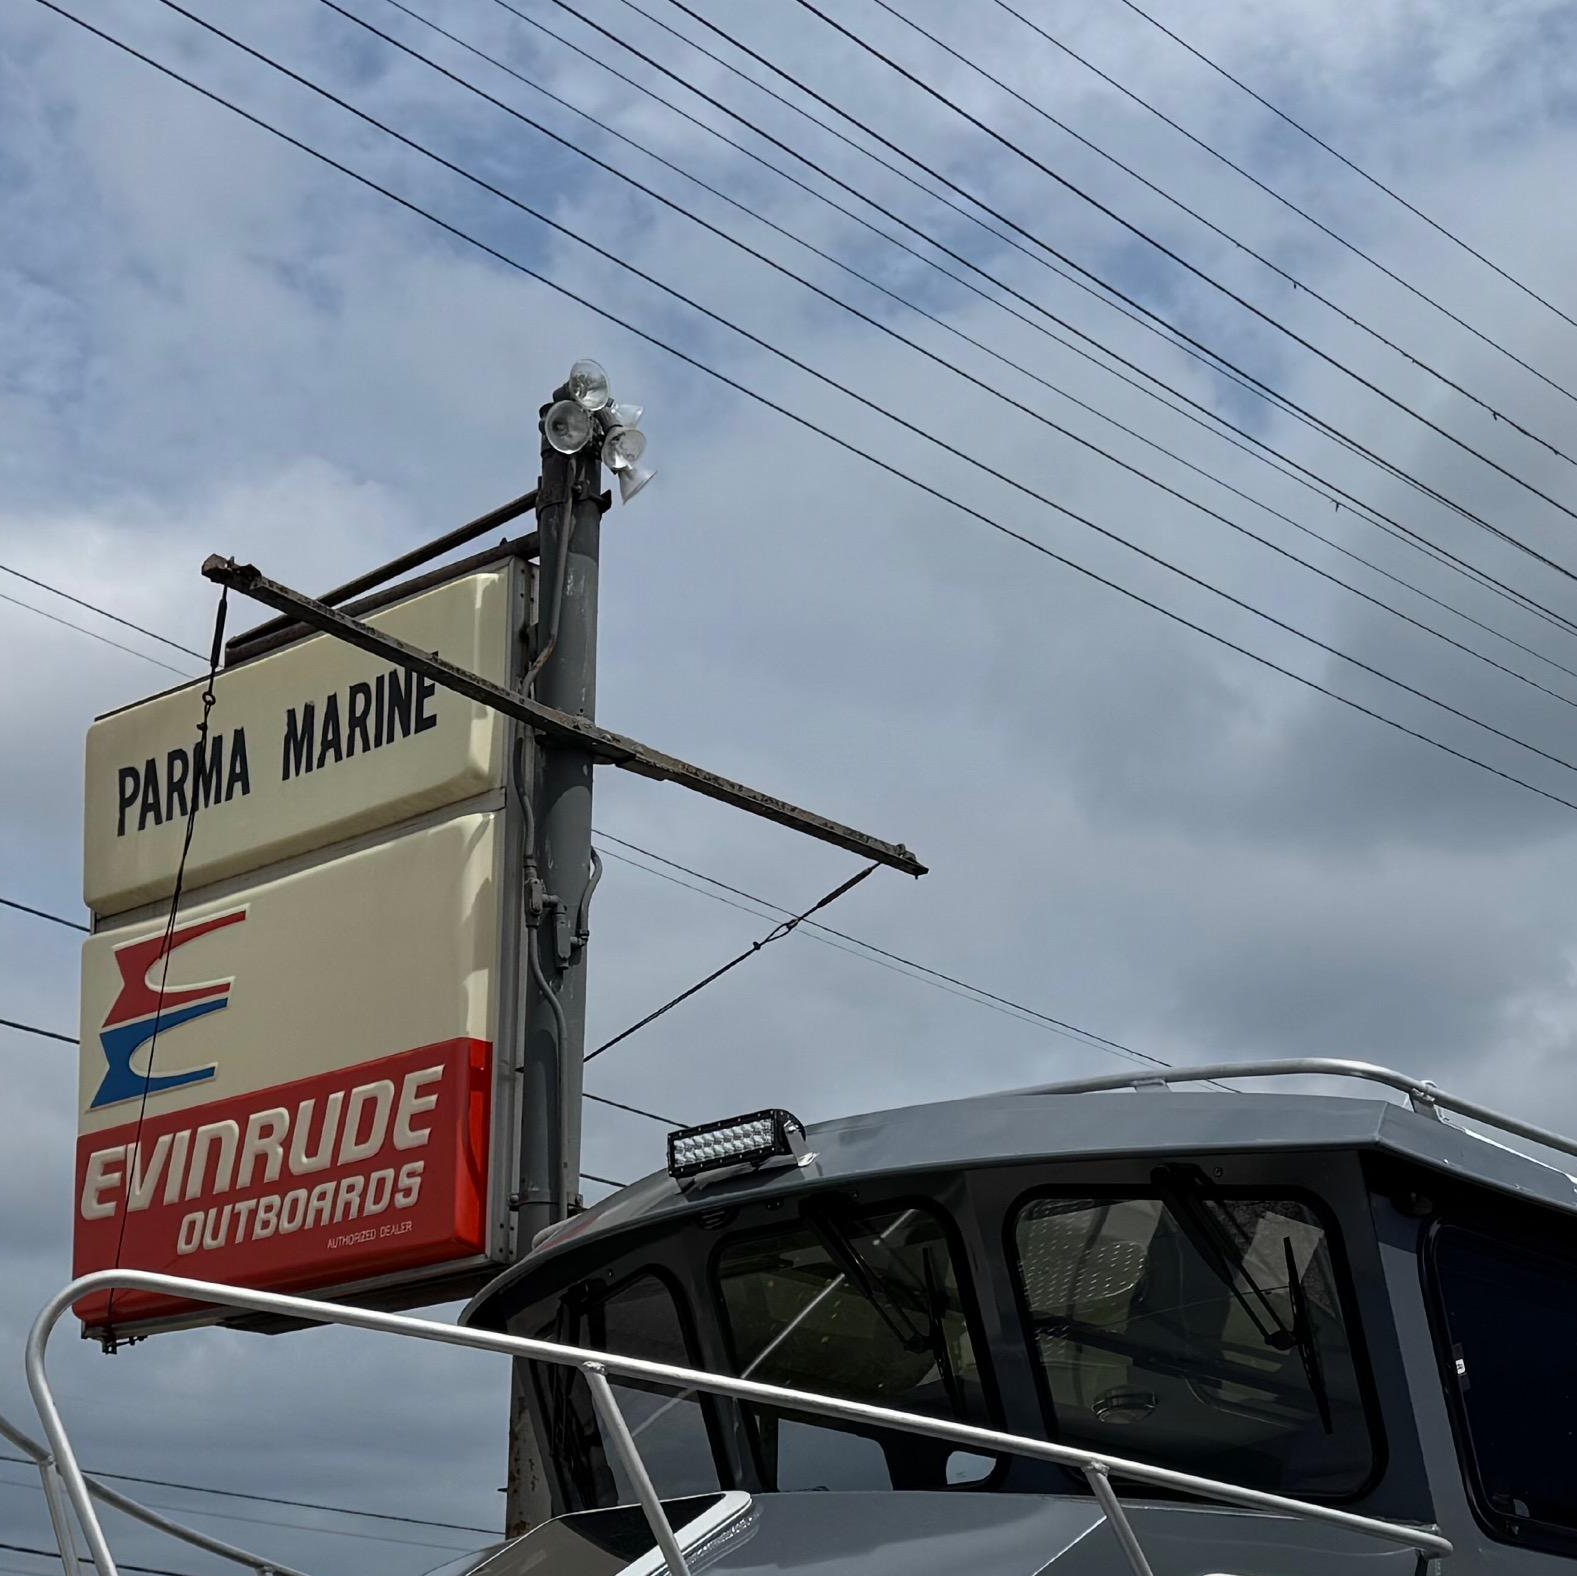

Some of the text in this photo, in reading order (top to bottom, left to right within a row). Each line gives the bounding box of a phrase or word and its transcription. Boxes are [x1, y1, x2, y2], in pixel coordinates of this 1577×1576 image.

[117, 655, 437, 837] PARMA MARINE
[81, 1064, 445, 1220] EVINRUDE
[177, 1160, 424, 1255] OUTBOARDS
[327, 1221, 412, 1249] AUTHORIZED DEALER
